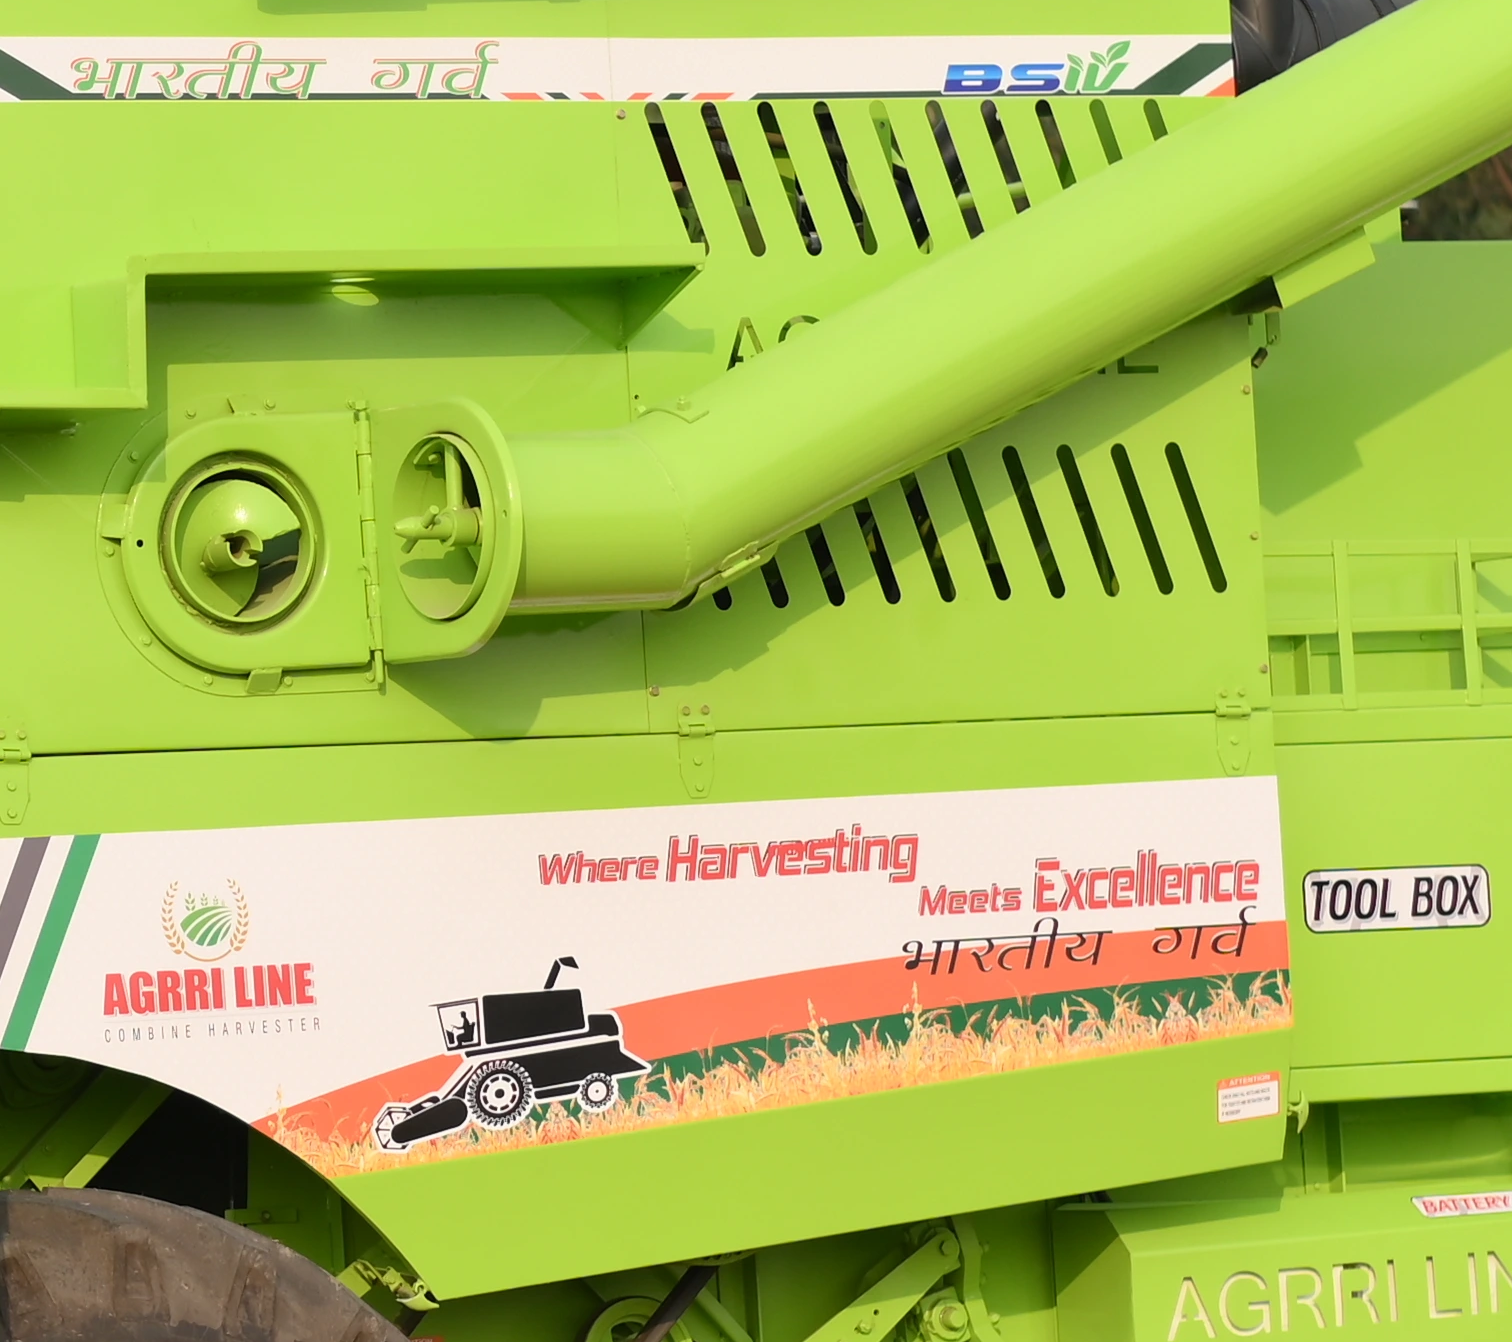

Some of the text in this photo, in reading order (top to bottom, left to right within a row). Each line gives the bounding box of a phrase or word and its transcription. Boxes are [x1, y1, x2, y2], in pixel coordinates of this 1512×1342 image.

[70, 40, 501, 99] भारतीय गर्व
[538, 823, 919, 885] Where Harvesting
[918, 849, 1260, 916] Meets Excellence
[1311, 875, 1481, 922] TOOL BOX
[902, 905, 1257, 975] भारतीय गर्व
[103, 963, 317, 1017] AGRRI LINE
[104, 1017, 321, 1043] COMBINE HARVESTER
[1228, 1074, 1271, 1087] ATTENTION
[1422, 1195, 1510, 1214] BATTERY
[1167, 1259, 1399, 1342] AGRRI
